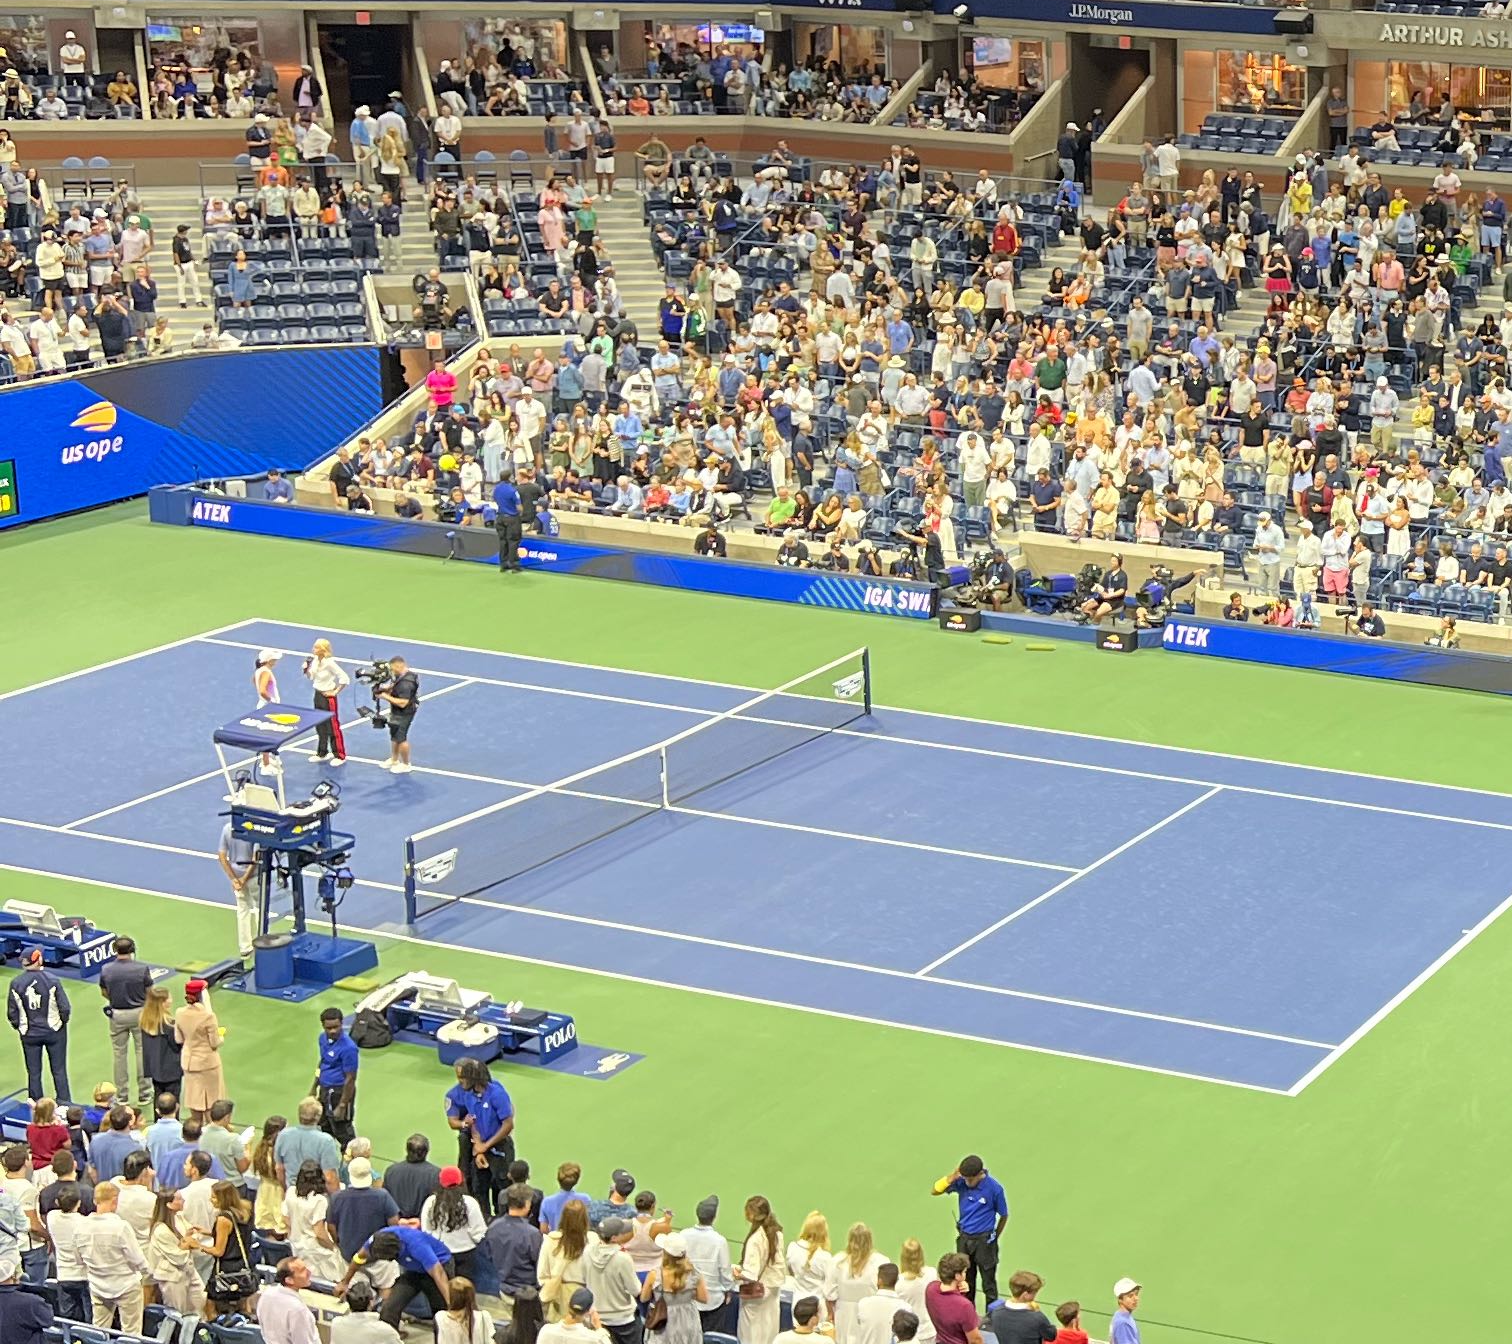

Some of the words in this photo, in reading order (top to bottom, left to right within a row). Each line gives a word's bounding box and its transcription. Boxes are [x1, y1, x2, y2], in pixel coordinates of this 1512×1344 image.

[1379, 23, 1465, 47] ARTHUR
[62, 443, 84, 464] us
[193, 501, 231, 523] ATEK
[863, 586, 893, 608] IGA
[1163, 623, 1210, 648] ATEK
[544, 1022, 575, 1054] POLO
